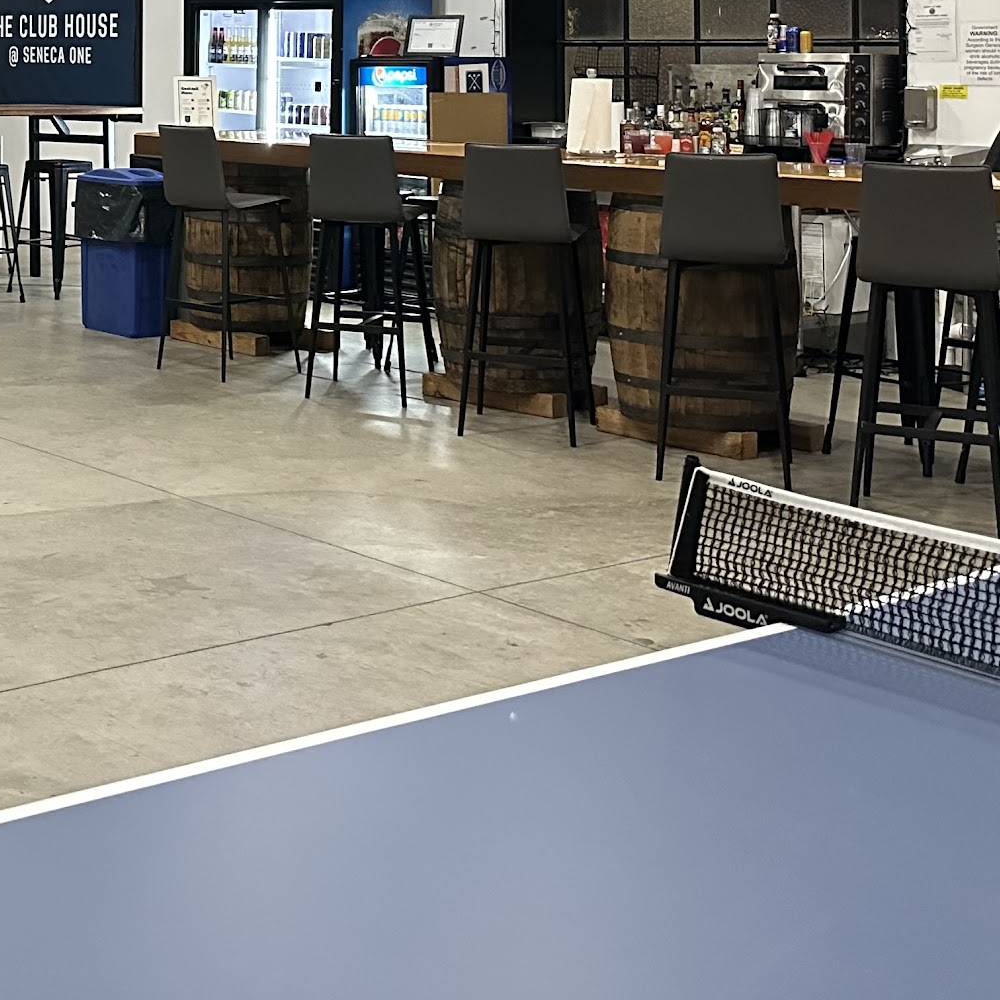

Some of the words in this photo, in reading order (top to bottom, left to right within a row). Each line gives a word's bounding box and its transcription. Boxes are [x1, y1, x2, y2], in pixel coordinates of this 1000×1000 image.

[20, 14, 58, 38] CLUB
[64, 13, 119, 38] HOUSE
[9, 46, 19, 67] @
[23, 46, 66, 64] SENECA
[69, 46, 92, 64] ONE
[736, 481, 772, 497] JOOLA
[666, 581, 691, 594] AVANTI
[715, 602, 767, 625] JOOLA
